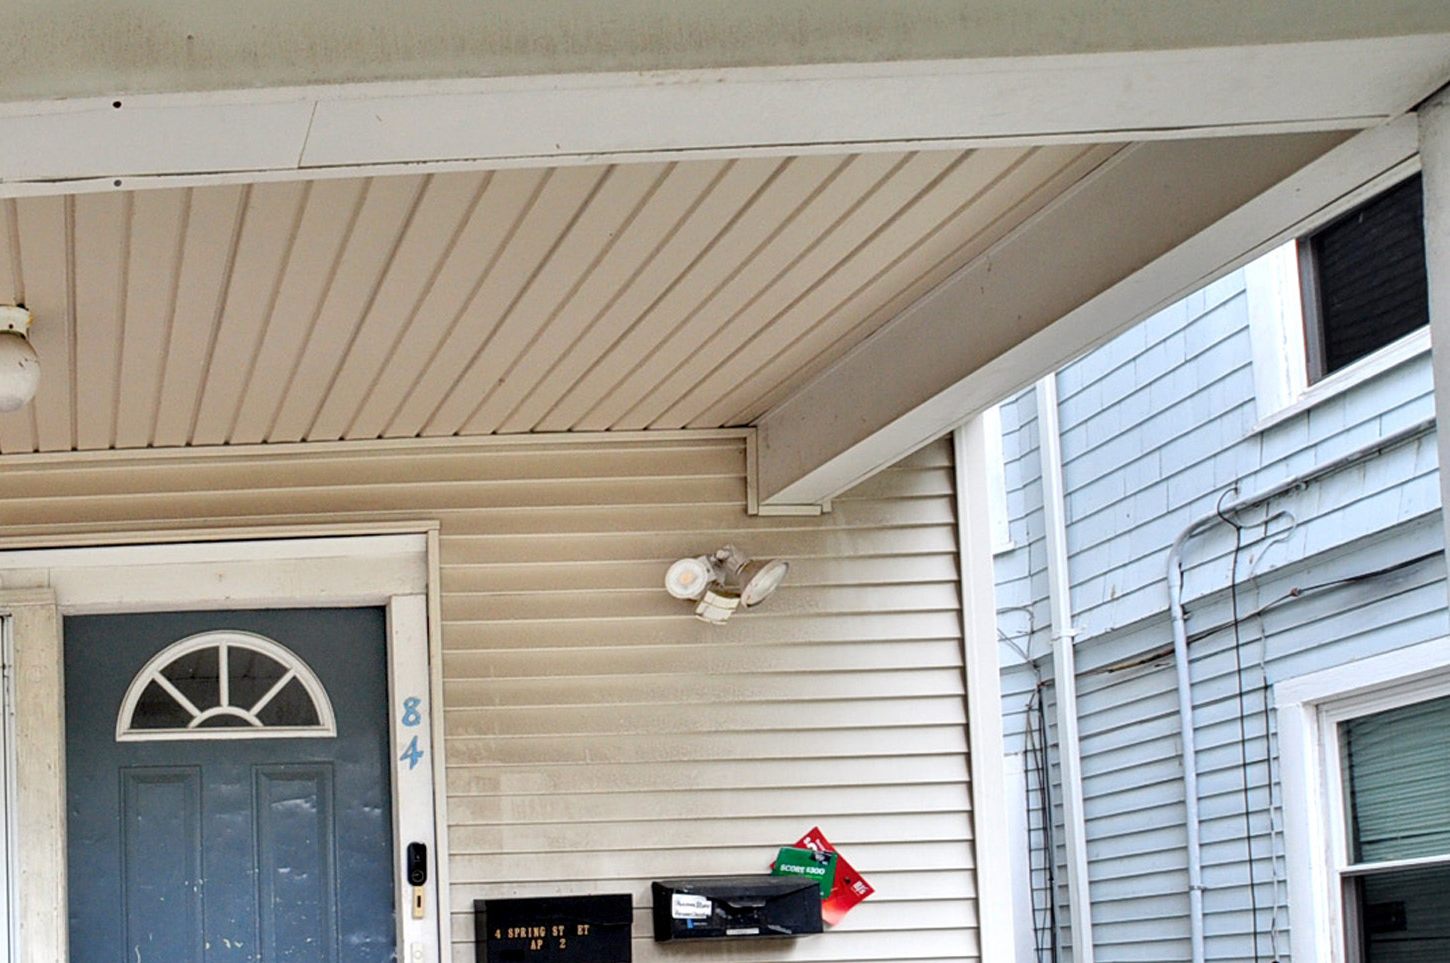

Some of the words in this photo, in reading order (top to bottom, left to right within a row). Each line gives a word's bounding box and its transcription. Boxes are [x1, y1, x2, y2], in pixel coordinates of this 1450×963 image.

[507, 926, 547, 939] SPRING
[552, 925, 565, 937] ST
[530, 939, 544, 950] AP
[559, 938, 567, 949] 2
